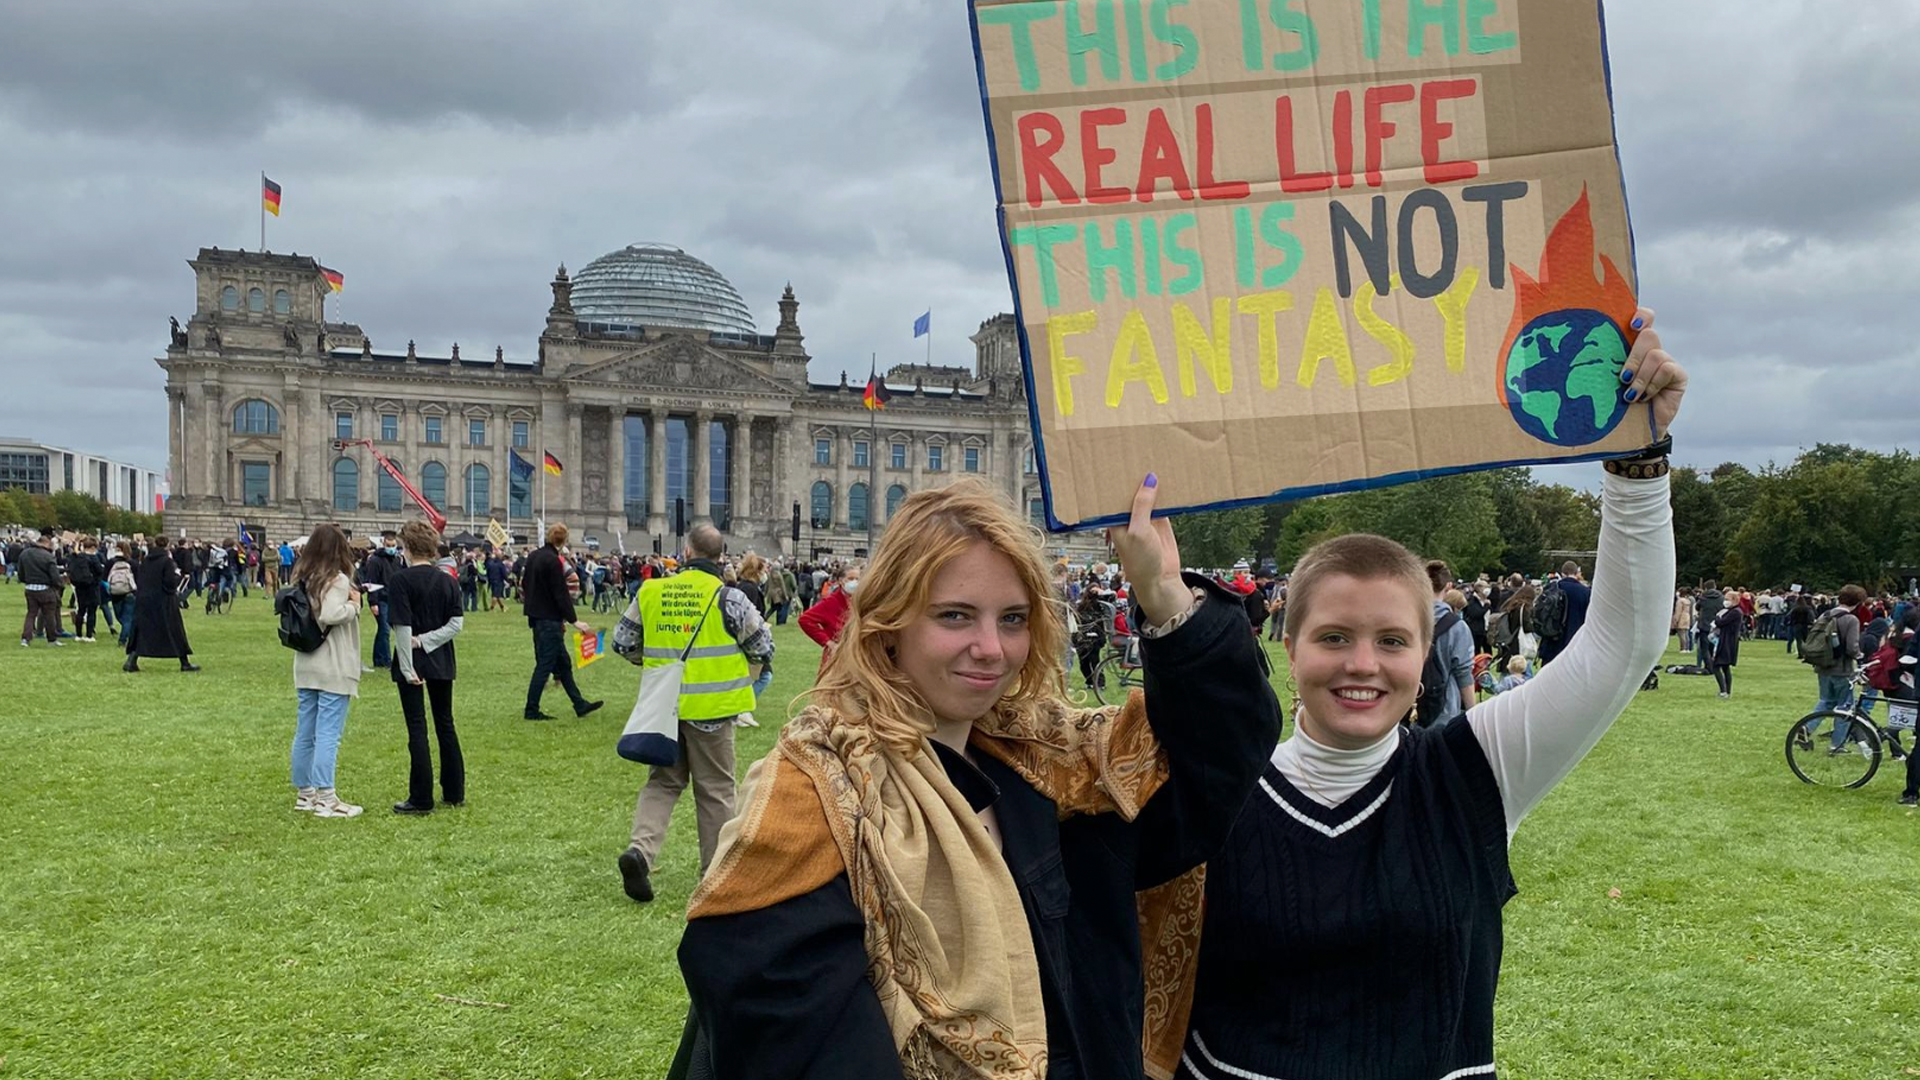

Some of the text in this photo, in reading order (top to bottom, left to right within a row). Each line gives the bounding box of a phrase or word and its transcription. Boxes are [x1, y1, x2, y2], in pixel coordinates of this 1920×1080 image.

[980, 0, 1199, 91] THIS
[1240, 0, 1319, 71] IS
[1017, 79, 1479, 207] REAL LIFE
[1010, 180, 1529, 306] THIS IS NOT
[1046, 266, 1480, 417] FANTASY
[656, 622, 682, 634] junge
[661, 609, 673, 617] wie
